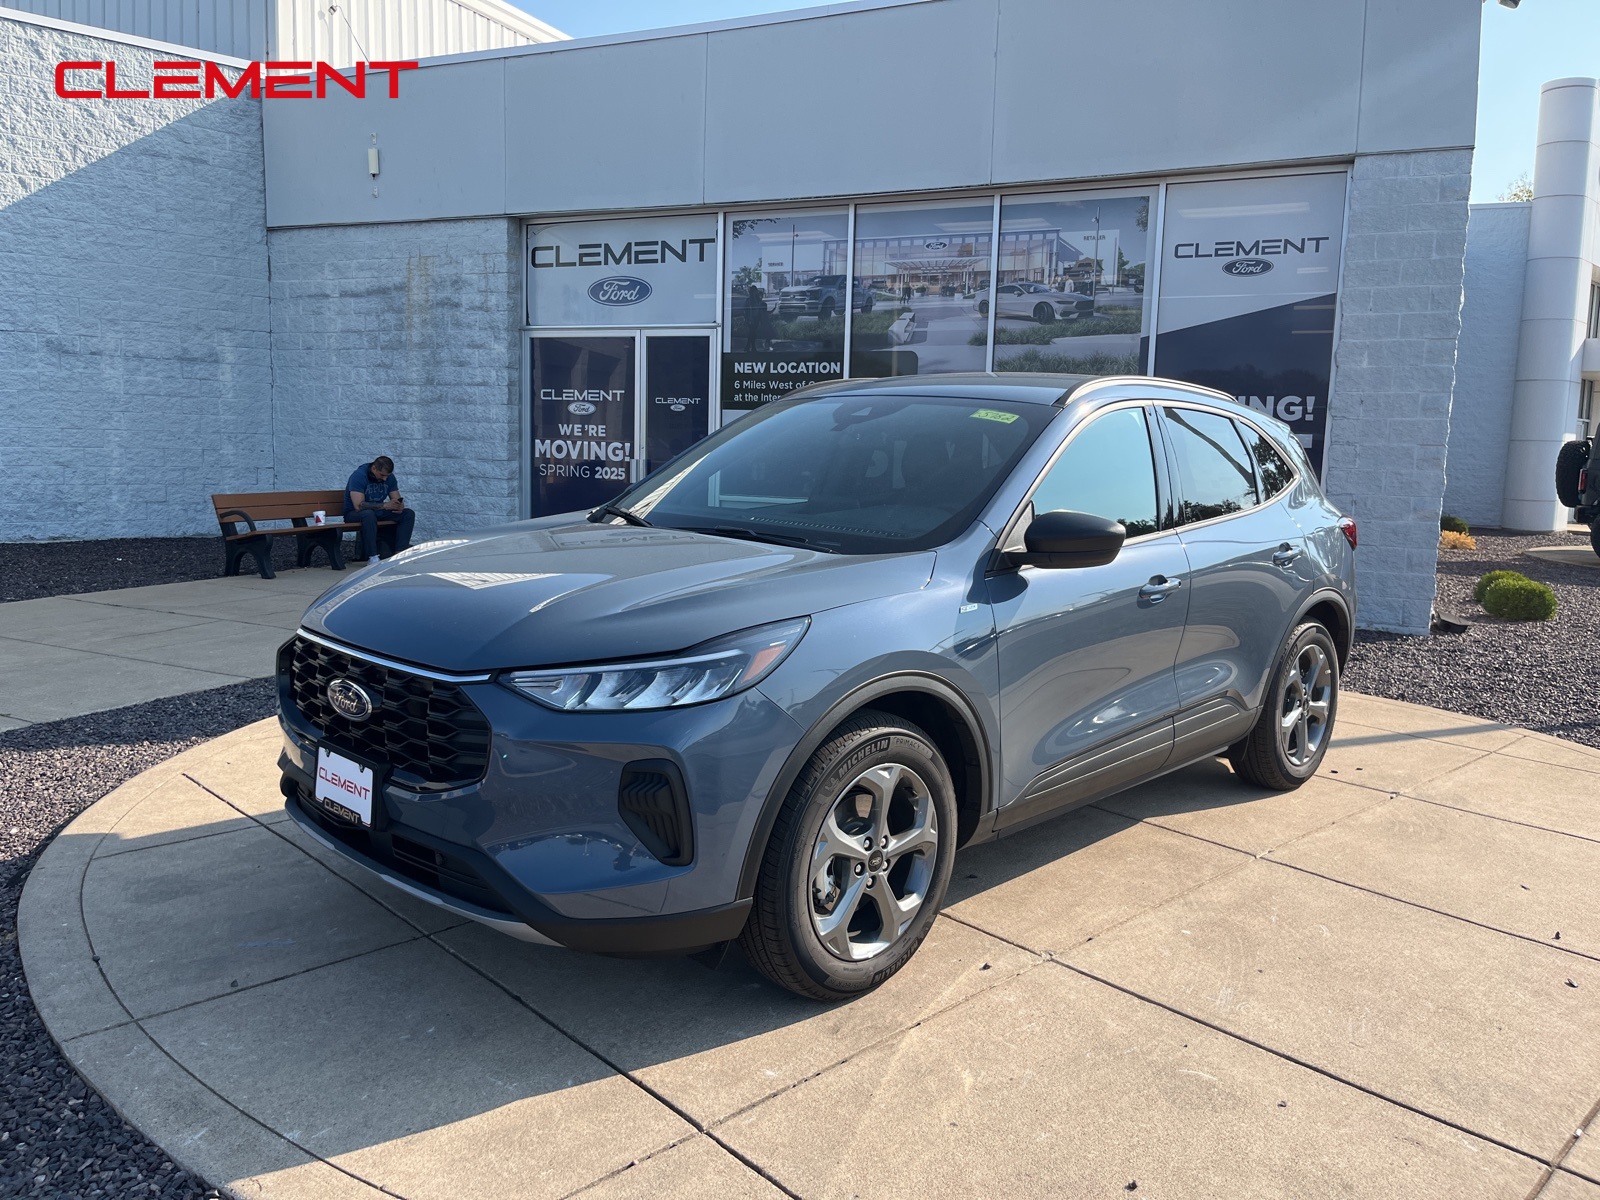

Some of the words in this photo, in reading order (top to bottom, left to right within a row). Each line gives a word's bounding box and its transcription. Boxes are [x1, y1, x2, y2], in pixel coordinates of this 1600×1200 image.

[531, 238, 716, 269] CLEMENT
[1174, 236, 1330, 259] CLEMENT
[1232, 261, 1264, 274] Ford
[599, 279, 640, 301] Ford
[734, 362, 767, 374] NEW
[770, 361, 841, 374] LOCATION
[734, 380, 741, 389] 6
[743, 380, 766, 389] Miles
[769, 380, 793, 389] West
[540, 389, 625, 402] CLEMENT
[734, 393, 743, 402] at
[745, 392, 759, 402] the
[558, 423, 606, 437] WE'RE
[535, 439, 631, 462] MOVING!
[540, 463, 591, 478] SPRING
[594, 466, 626, 480] 2025
[838, 738, 889, 777] MICHELIN
[318, 766, 371, 800] CLEMENT
[324, 798, 360, 824] CLEMENT
